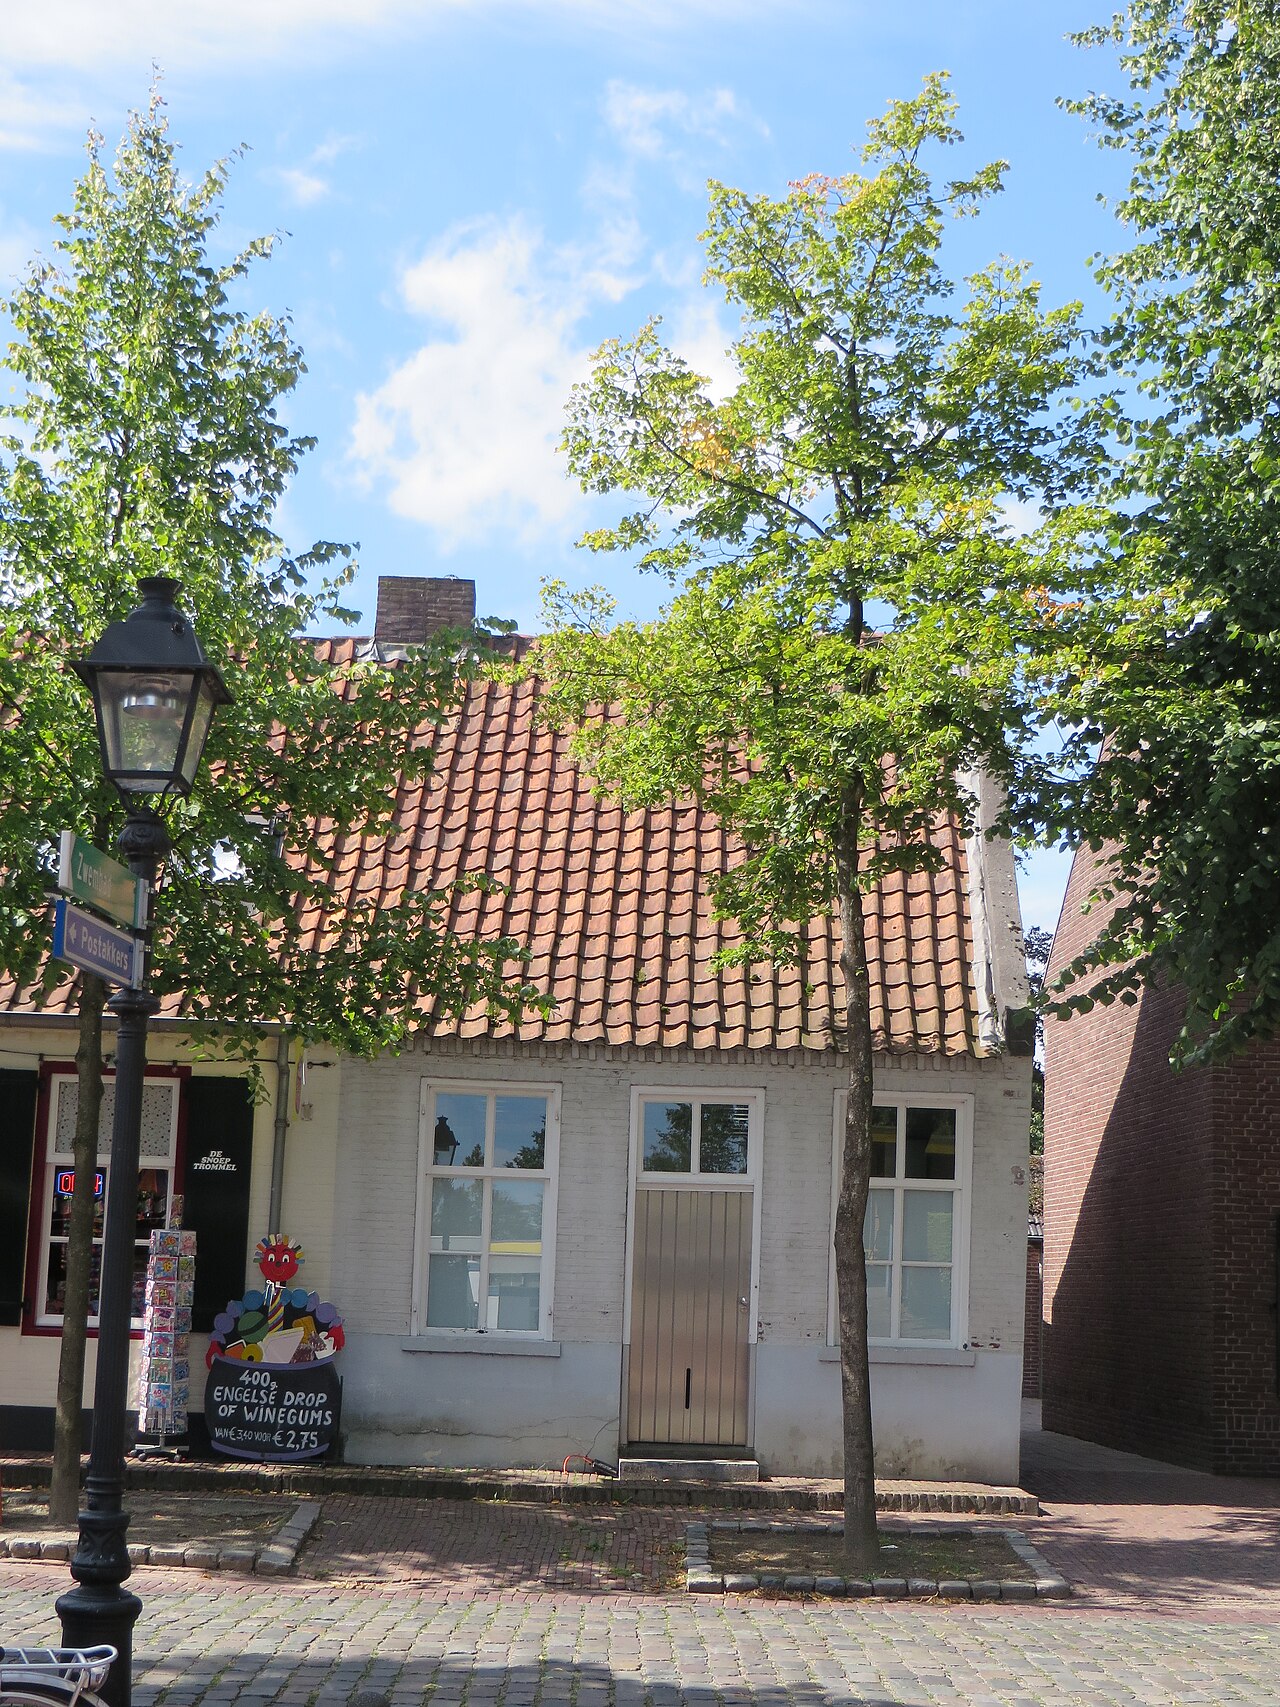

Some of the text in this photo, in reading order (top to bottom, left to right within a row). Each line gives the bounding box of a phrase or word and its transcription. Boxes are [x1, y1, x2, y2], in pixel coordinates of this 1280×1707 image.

[81, 926, 129, 970] Postakkers
[201, 1156, 231, 1164] SNOEP
[209, 1150, 223, 1158] DE
[193, 1163, 238, 1171] TROMMEL
[213, 1386, 328, 1407] ENGELSE DROP
[218, 1404, 238, 1417] OF
[214, 1427, 228, 1438] VAN
[254, 1431, 272, 1442] VOOR
